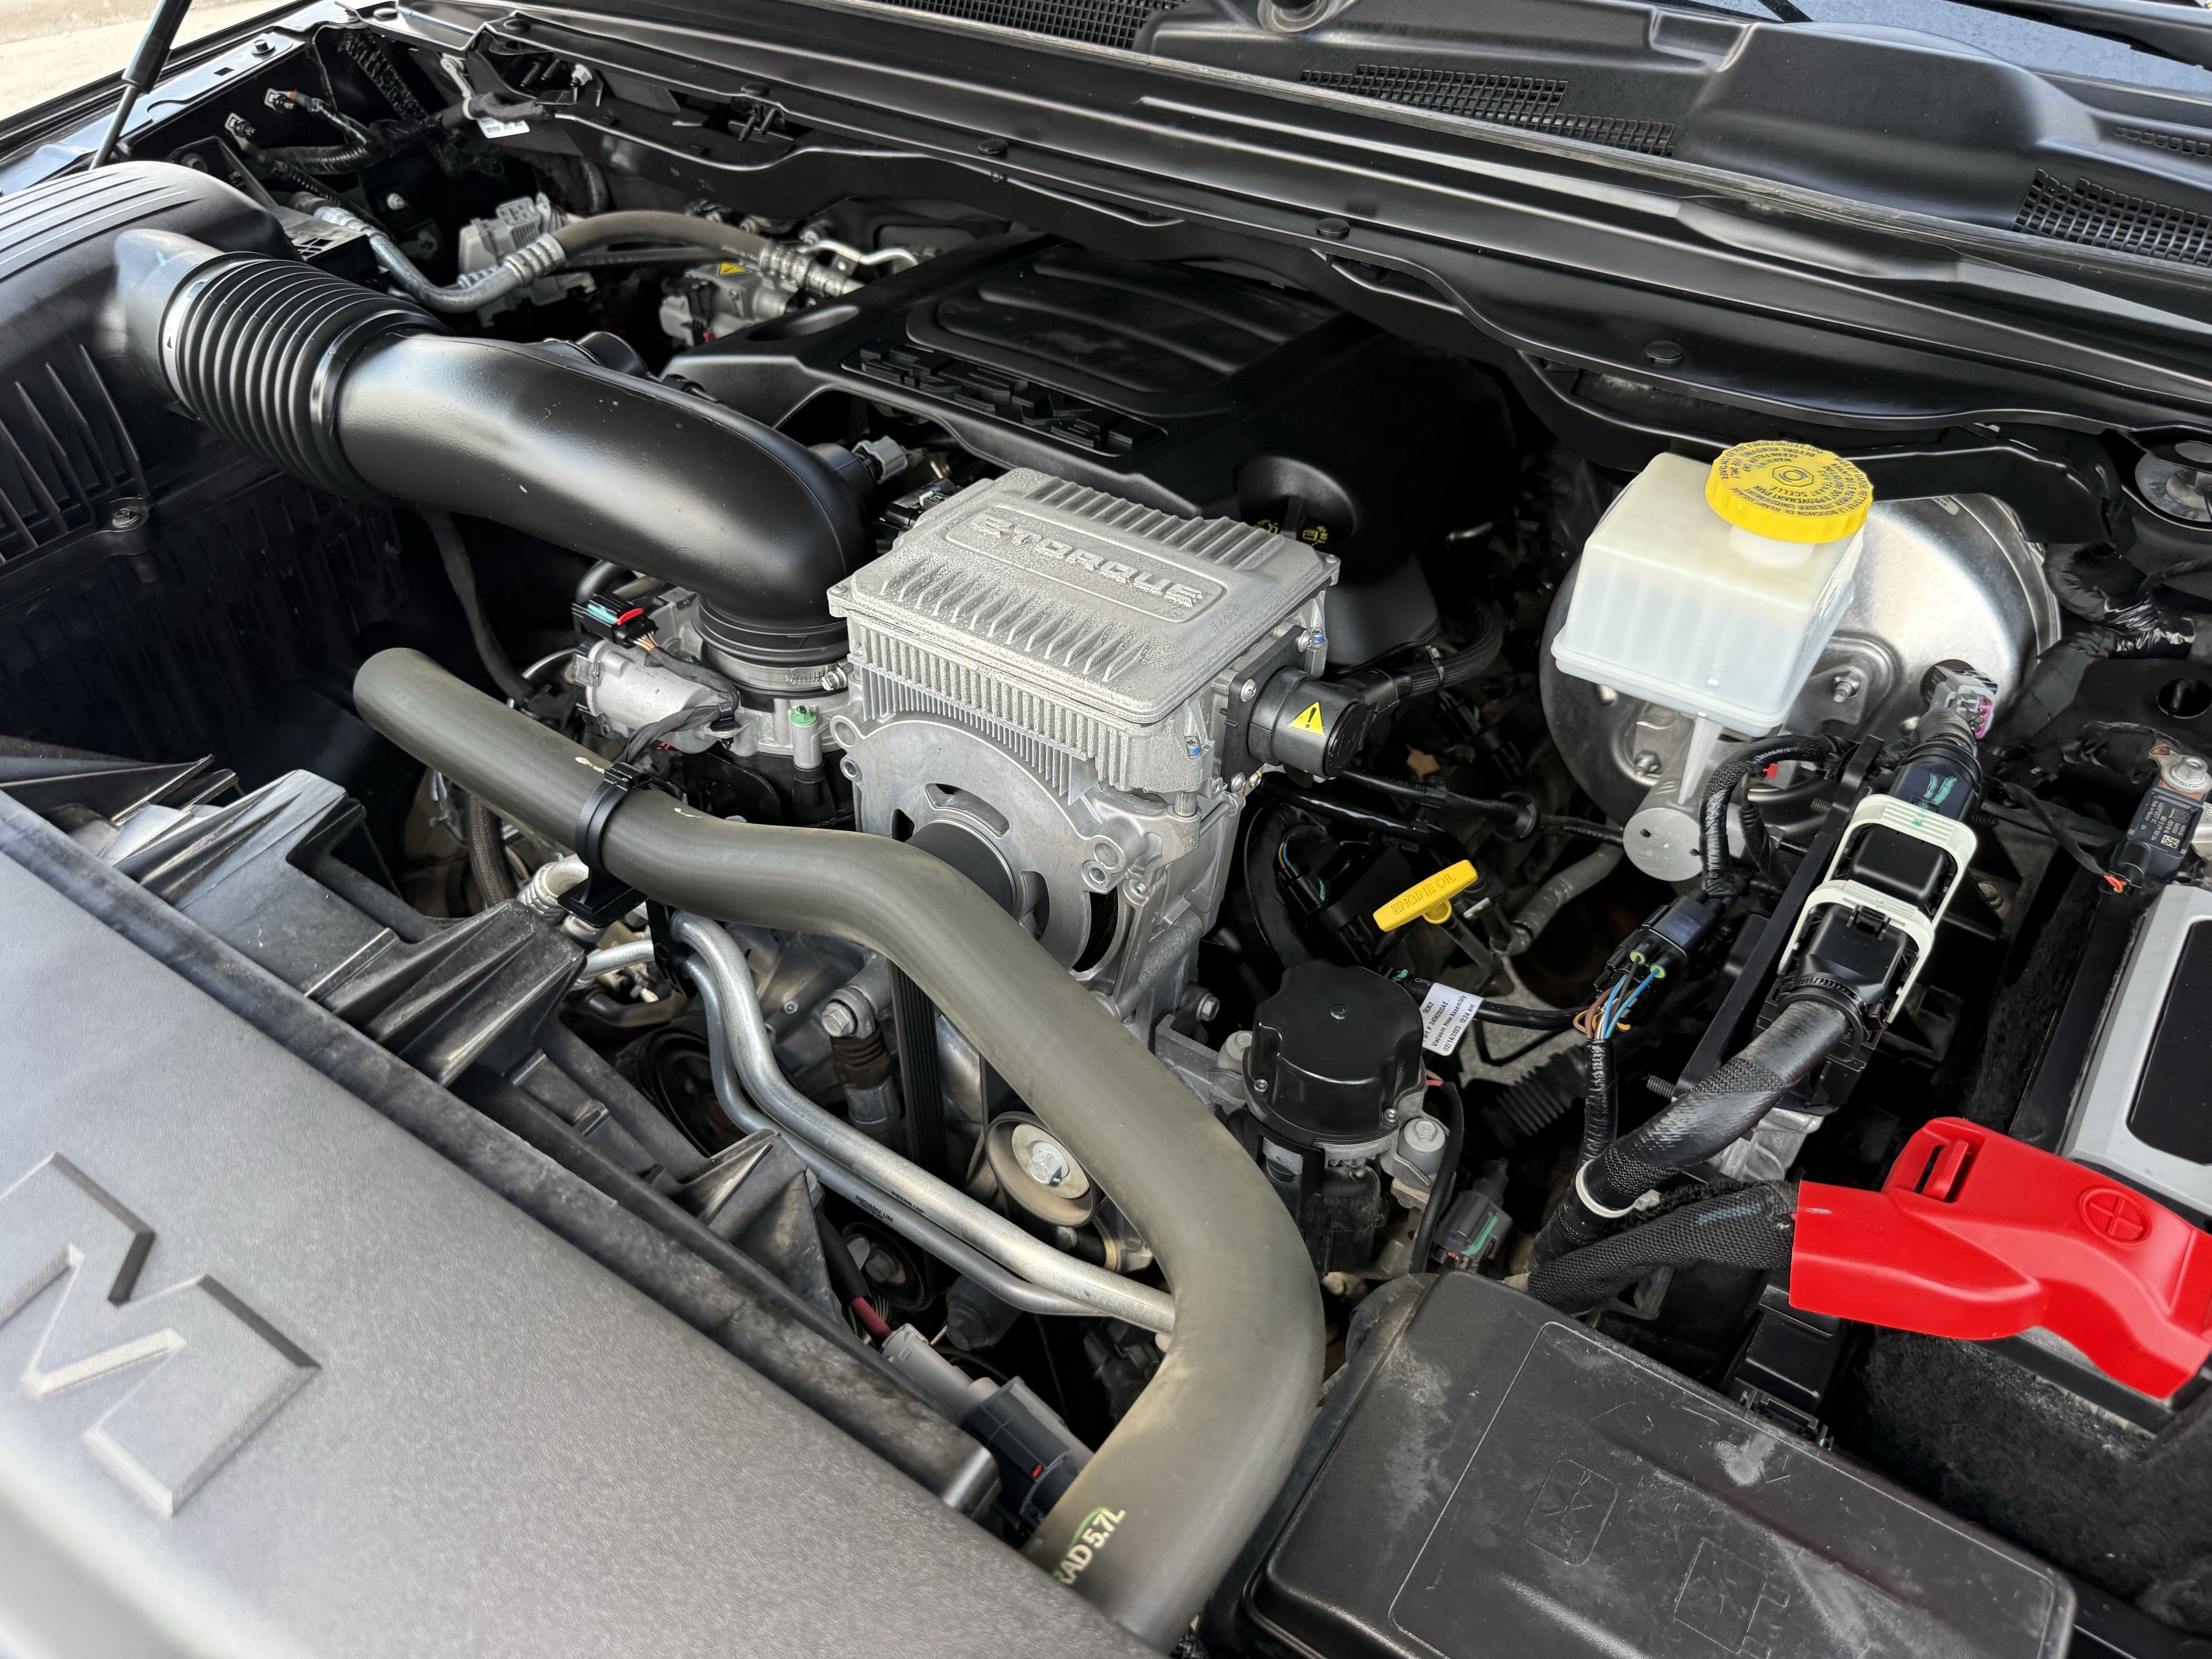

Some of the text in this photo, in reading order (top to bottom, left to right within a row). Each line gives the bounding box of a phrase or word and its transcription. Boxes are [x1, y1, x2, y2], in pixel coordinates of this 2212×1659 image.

[1725, 445, 1746, 457] SEALED
[1783, 448, 1815, 457] BEFORE
[1748, 453, 1770, 463] FILLER
[1834, 457, 1849, 467] MISE
[1729, 467, 1740, 479] ONLY
[1742, 463, 1751, 472] CAP
[1830, 464, 1851, 477] AVANT
[1810, 471, 1832, 496] CONTENANT
[1832, 471, 1844, 490] LIQUIDE
[1752, 486, 1772, 496] D'UN
[1829, 489, 1842, 499] DOT
[1731, 488, 1781, 512] REMPLISSAGE
[1743, 489, 1795, 509] UNIQUEMENT
[1771, 492, 1826, 503] PROVENANT
[1847, 490, 1868, 510] NETTOYER
[1391, 874, 1456, 915] ENGINE OIL
[1432, 995, 1467, 1046] Vacuum Hose Assembly
[1443, 1025, 1461, 1051] 02/14/2023
[1468, 1004, 1475, 1012] am
[883, 1212, 894, 1222] LINE
[1082, 1510, 1126, 1548] 5.7L
